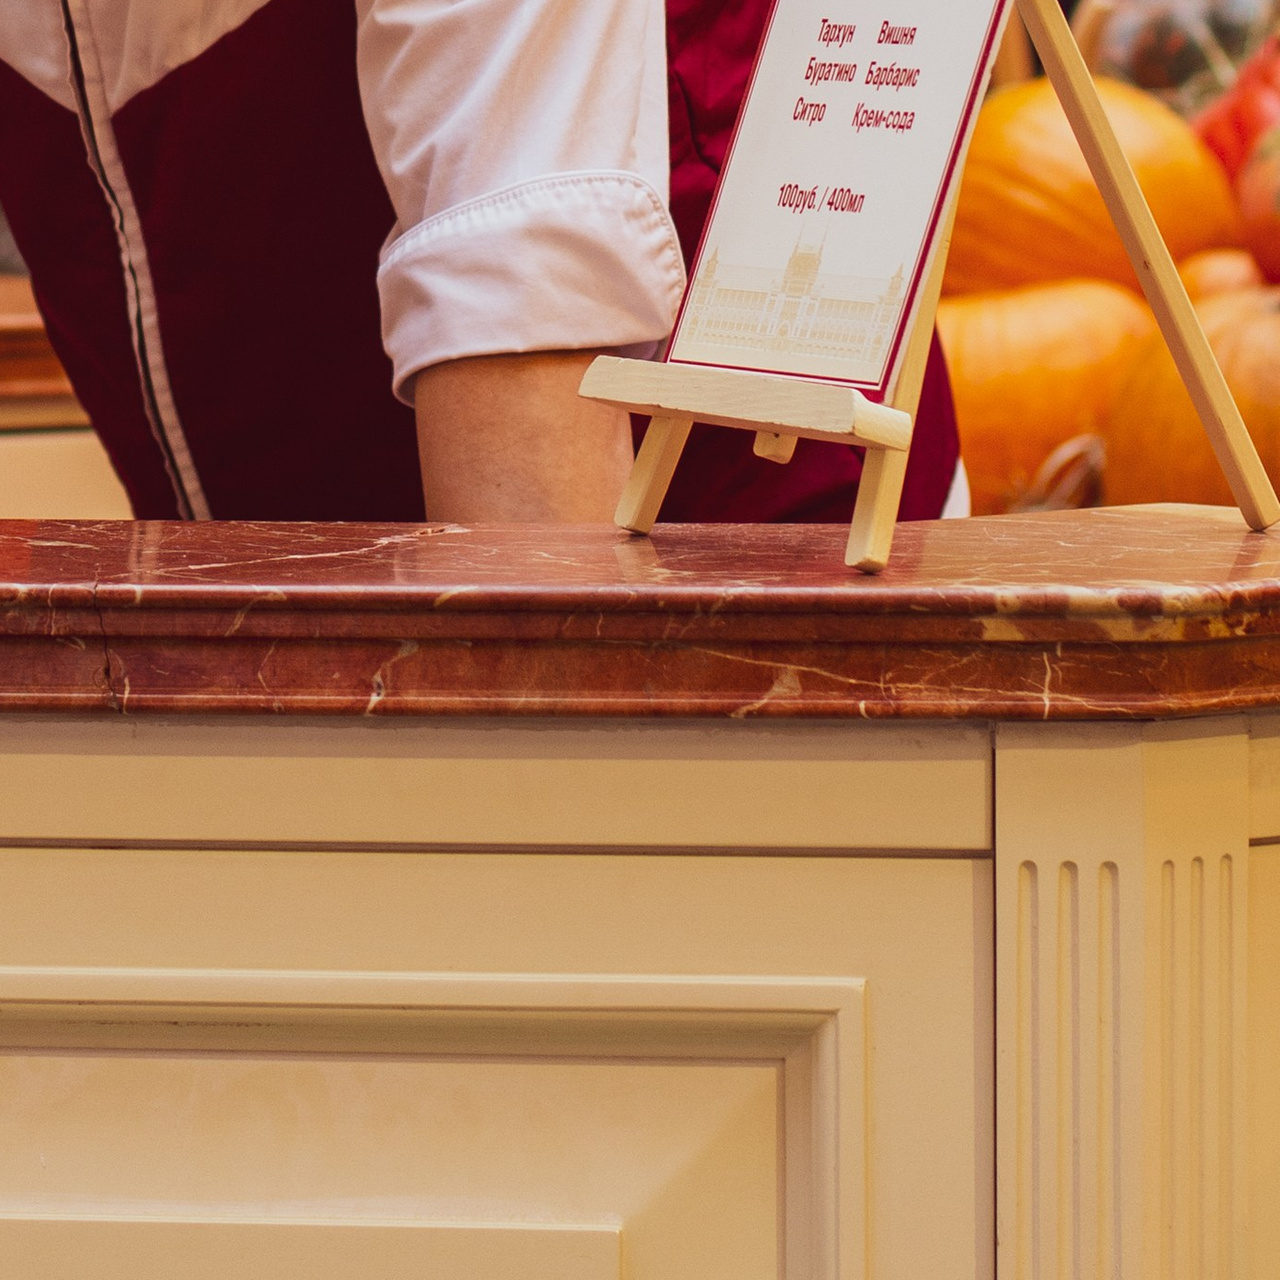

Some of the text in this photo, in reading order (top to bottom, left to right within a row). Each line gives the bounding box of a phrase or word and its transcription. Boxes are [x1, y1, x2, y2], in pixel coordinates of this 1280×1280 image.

[817, 18, 917, 48] Тархун Вишня
[804, 57, 920, 92] Буратино Барбарис
[792, 96, 916, 134] Ситро Крем-сода
[777, 183, 818, 214] 100руб.
[827, 188, 866, 213] 400мл
